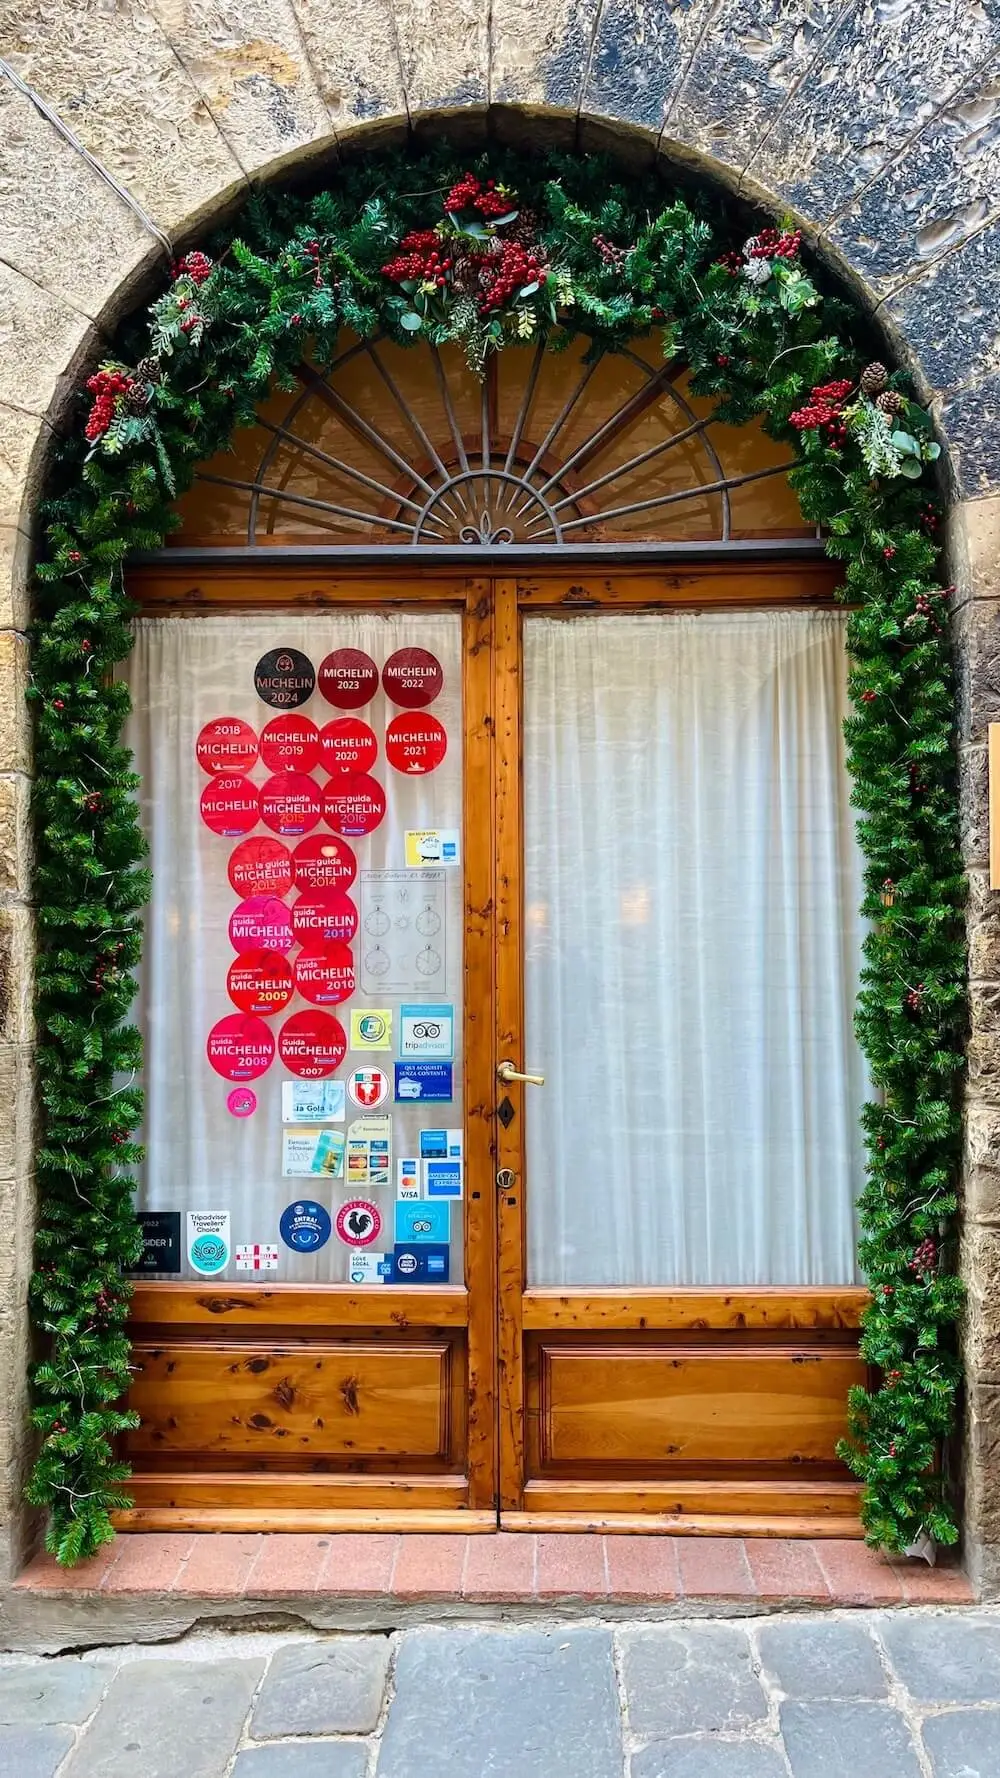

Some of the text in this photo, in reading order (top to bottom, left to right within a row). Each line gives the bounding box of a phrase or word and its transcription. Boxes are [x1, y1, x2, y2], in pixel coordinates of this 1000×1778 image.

[324, 668, 373, 678] MICHELIN
[387, 666, 437, 677] MICHELIN
[257, 676, 313, 689] MICHELIN
[337, 680, 360, 690] 2023
[401, 679, 424, 689] 2022
[271, 692, 298, 703] 2024
[214, 725, 241, 735] 2018
[263, 732, 318, 743] MICHELIN
[388, 732, 442, 743] MICHELIN
[322, 738, 373, 748] MICHELIN
[197, 743, 259, 754] MICHELIN
[278, 745, 304, 755] 2019
[403, 746, 427, 756] 2021
[335, 751, 358, 761] 2020
[218, 779, 242, 789] 2017
[285, 794, 310, 804] guida
[346, 794, 371, 804] guida
[263, 803, 321, 814] MICHELIN
[324, 803, 381, 814] MICHELIN
[279, 813, 305, 824] 2015
[340, 813, 366, 824] 2016
[265, 858, 290, 870] guida
[316, 858, 342, 867] guida
[234, 868, 291, 882] MICHELIN
[296, 866, 352, 878] MICHELIN
[309, 877, 337, 888] 2014
[293, 908, 316, 917] guida
[233, 918, 255, 926] guida
[293, 916, 354, 928] MICHELIN
[324, 929, 352, 938] 2011
[263, 939, 292, 948] 2012
[296, 961, 318, 970] guida
[230, 972, 252, 981] guida
[296, 968, 355, 981] MICHELIN
[230, 980, 292, 991] MICHELIN
[326, 980, 355, 990] 2010
[258, 991, 288, 1001] 2009
[210, 1038, 233, 1047] guida
[210, 1045, 272, 1055] MICHELIN
[238, 1057, 268, 1067] 2008
